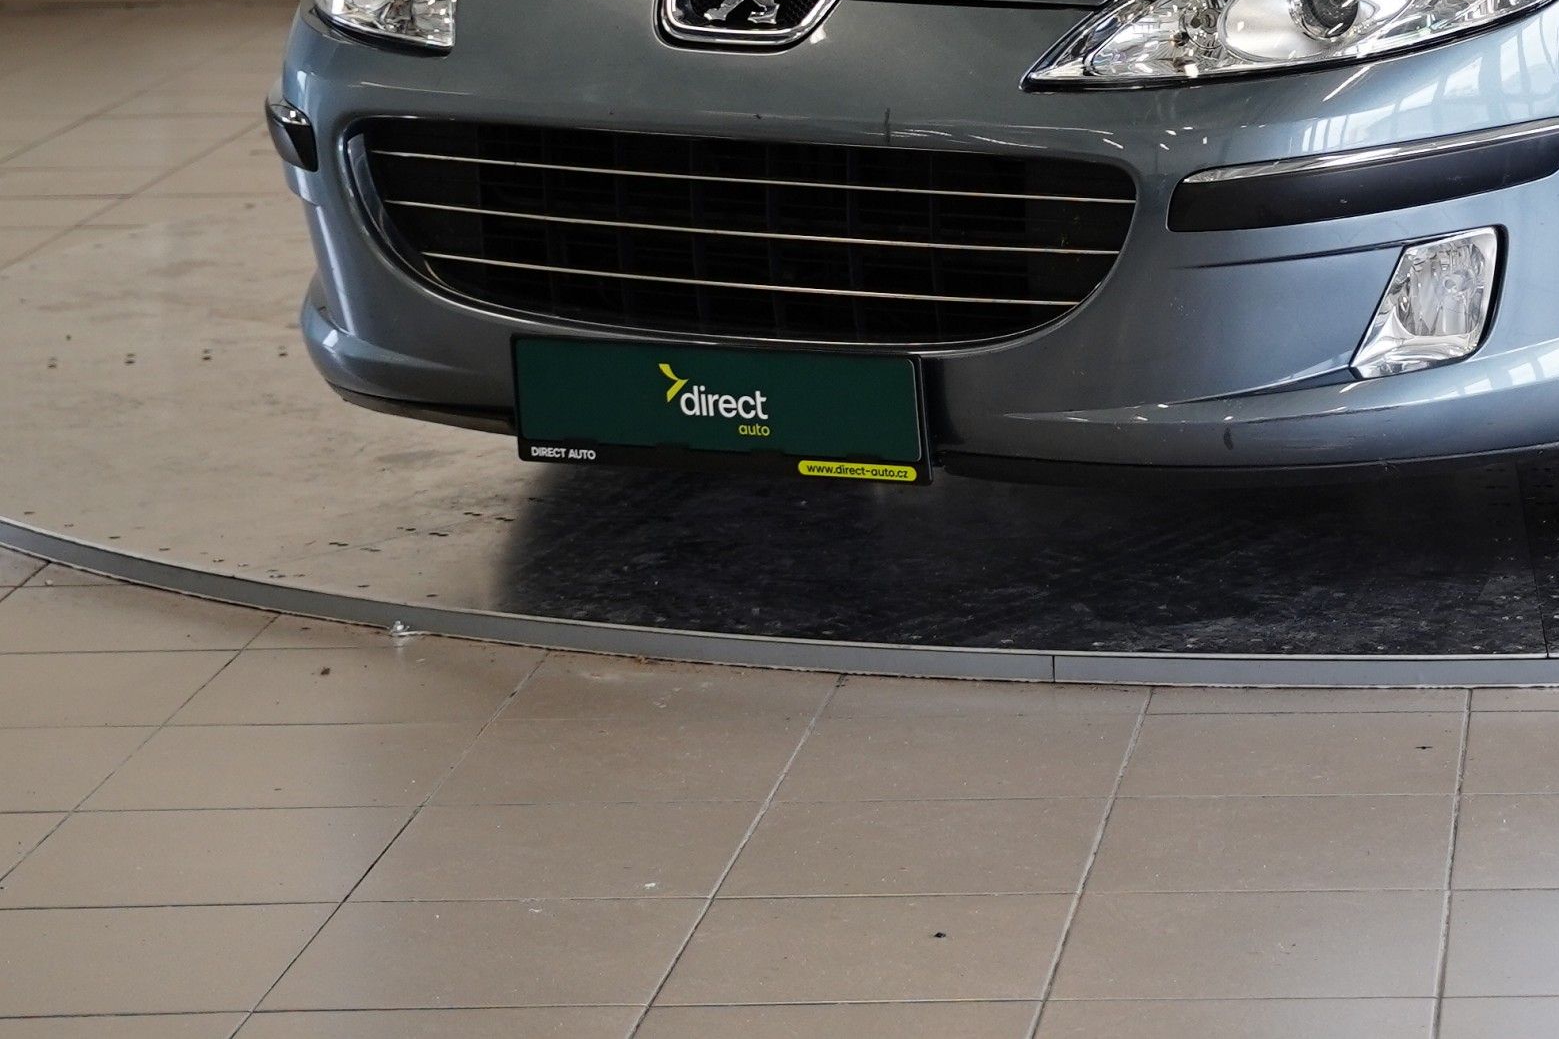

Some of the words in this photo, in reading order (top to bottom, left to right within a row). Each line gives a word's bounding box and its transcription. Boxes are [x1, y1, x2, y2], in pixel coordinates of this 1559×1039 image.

[680, 385, 769, 420] direct
[738, 423, 771, 437] auto
[530, 446, 567, 458] DIRECT
[568, 448, 597, 460] AUTO
[806, 464, 909, 479] www.direct-auto.cz
